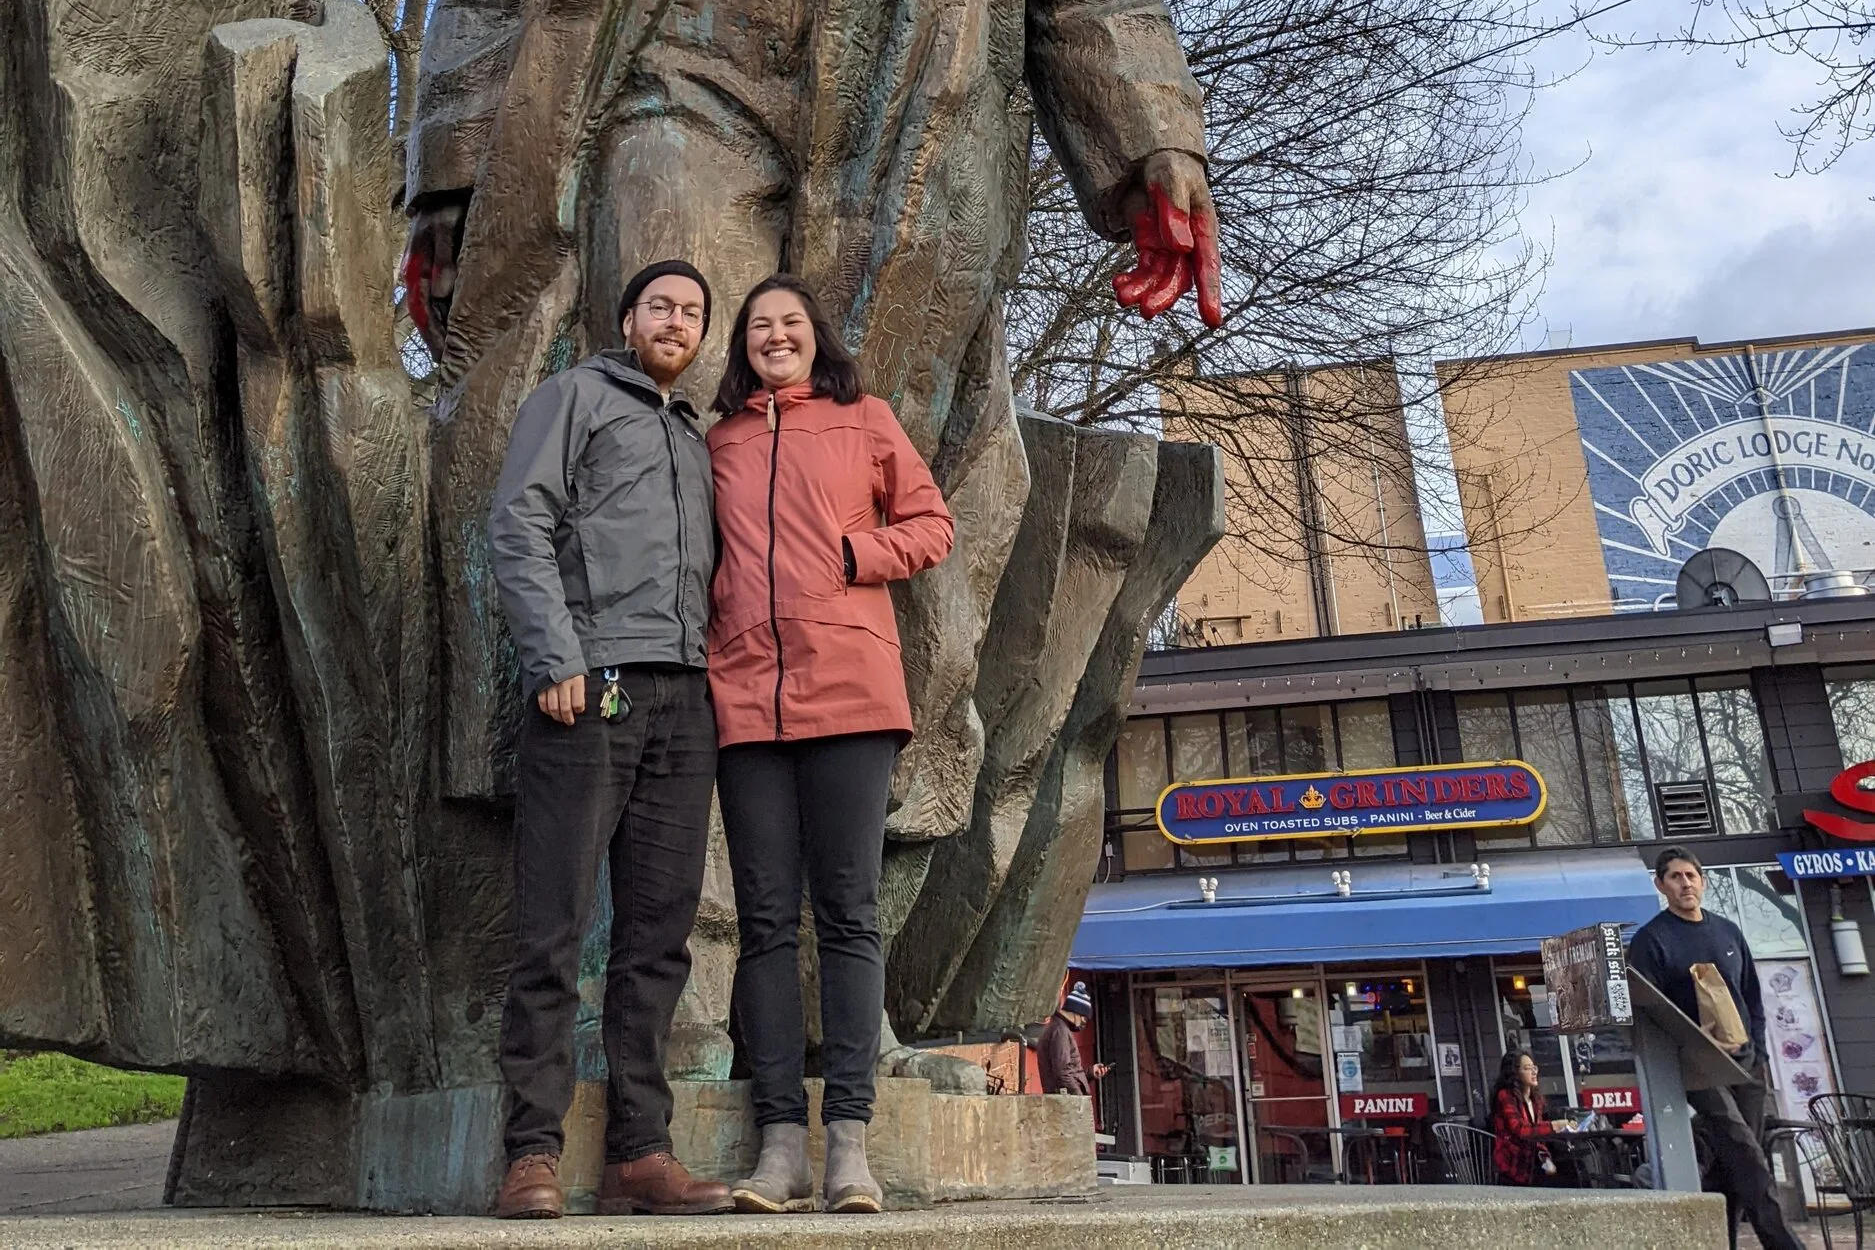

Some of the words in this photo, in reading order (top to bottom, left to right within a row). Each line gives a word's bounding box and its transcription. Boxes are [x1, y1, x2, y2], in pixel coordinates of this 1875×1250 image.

[1654, 441, 1735, 504] DORIC
[1736, 430, 1828, 459] LODGE
[1175, 786, 1295, 820] ROYAL
[1329, 772, 1530, 809] GRINDERS
[1225, 822, 1259, 833] OVEN
[1262, 817, 1320, 829] TOASTED
[1323, 815, 1359, 826] SUBS
[1370, 811, 1415, 823] PANINI
[1424, 810, 1443, 821] Beer
[1444, 809, 1452, 820] &
[1453, 808, 1477, 819] Cider
[1793, 853, 1843, 875] GYROS
[1607, 960, 1625, 981] sic
[1354, 1098, 1414, 1113] PANINI
[1592, 1092, 1633, 1108] DELI
